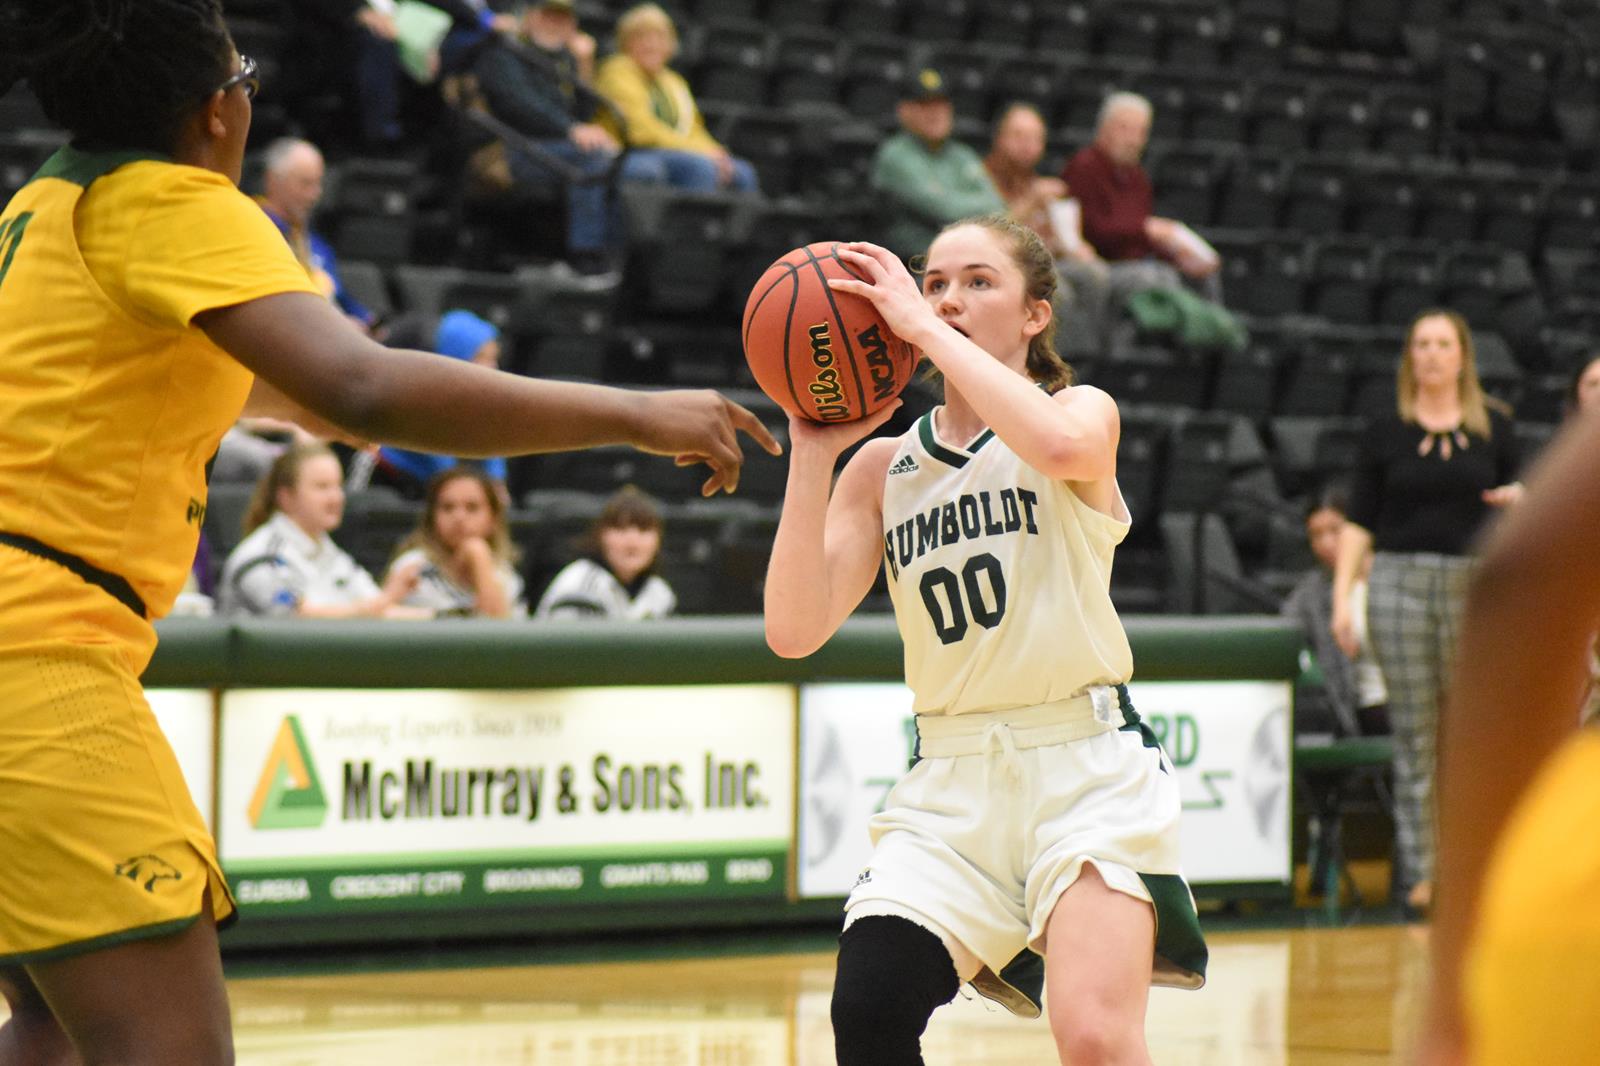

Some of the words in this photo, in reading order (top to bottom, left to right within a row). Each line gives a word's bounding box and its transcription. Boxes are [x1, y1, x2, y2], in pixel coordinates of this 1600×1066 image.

[808, 321, 850, 420] Wilson
[857, 323, 896, 402] NCAA
[888, 464, 920, 475] adidas
[884, 486, 1039, 583] HUMBOLDT
[919, 552, 1007, 645] 00
[341, 758, 545, 823] McMurray
[555, 762, 578, 814] &
[592, 750, 694, 817] Sons,
[704, 749, 770, 810] Inc.
[421, 870, 465, 896] CITY
